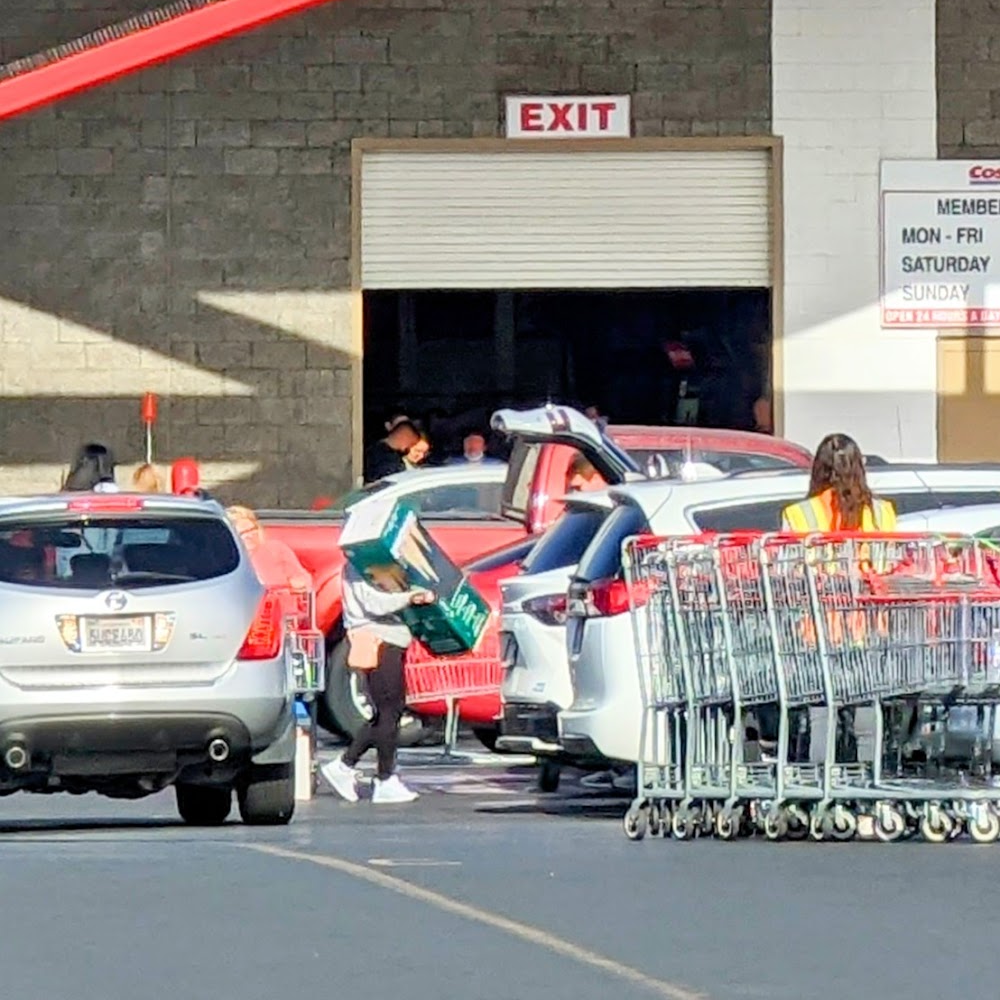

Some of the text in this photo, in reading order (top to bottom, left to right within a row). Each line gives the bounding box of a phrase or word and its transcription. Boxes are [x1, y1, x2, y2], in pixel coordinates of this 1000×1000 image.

[520, 102, 616, 132] EXIT
[902, 227, 941, 244] MON
[957, 227, 983, 244] FRI
[902, 256, 991, 273] SATURDAY
[902, 284, 970, 301] SUNDAY
